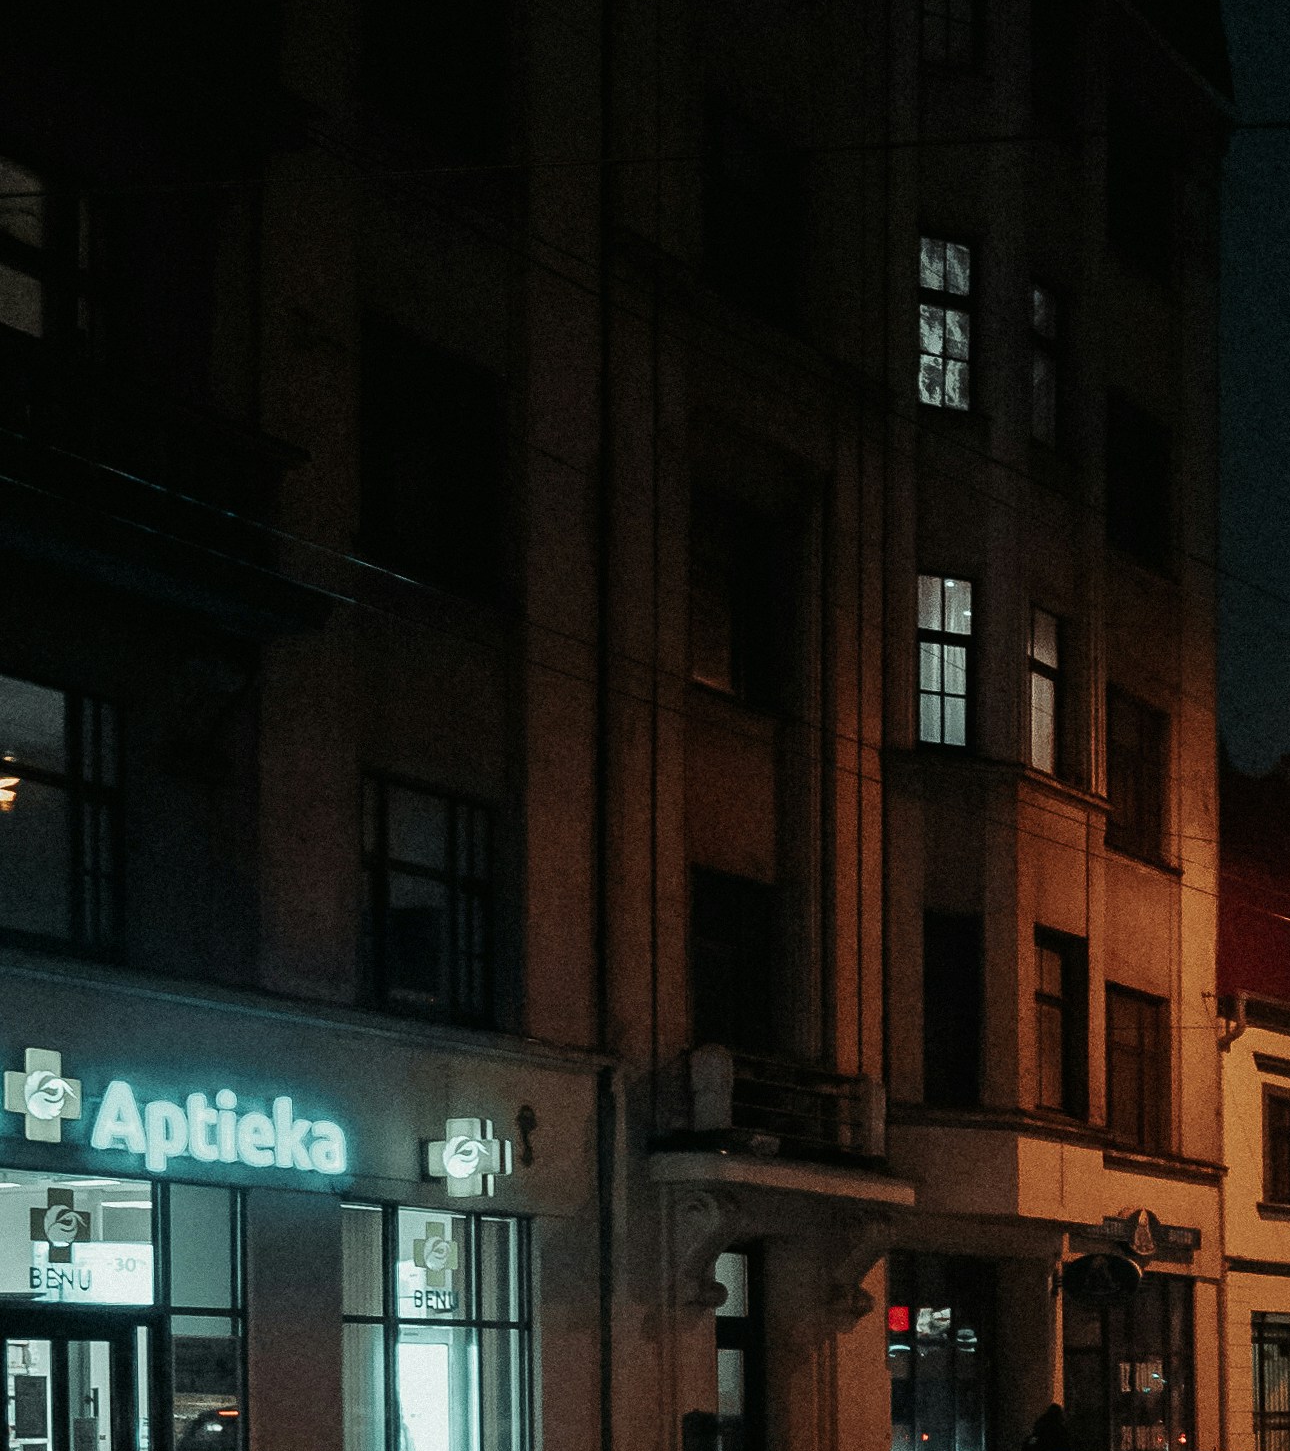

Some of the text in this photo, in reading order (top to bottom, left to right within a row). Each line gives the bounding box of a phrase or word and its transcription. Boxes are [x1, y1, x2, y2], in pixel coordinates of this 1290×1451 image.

[91, 1080, 347, 1174] Aptieka
[30, 1266, 91, 1290] BENU
[414, 1290, 459, 1310] BENU
